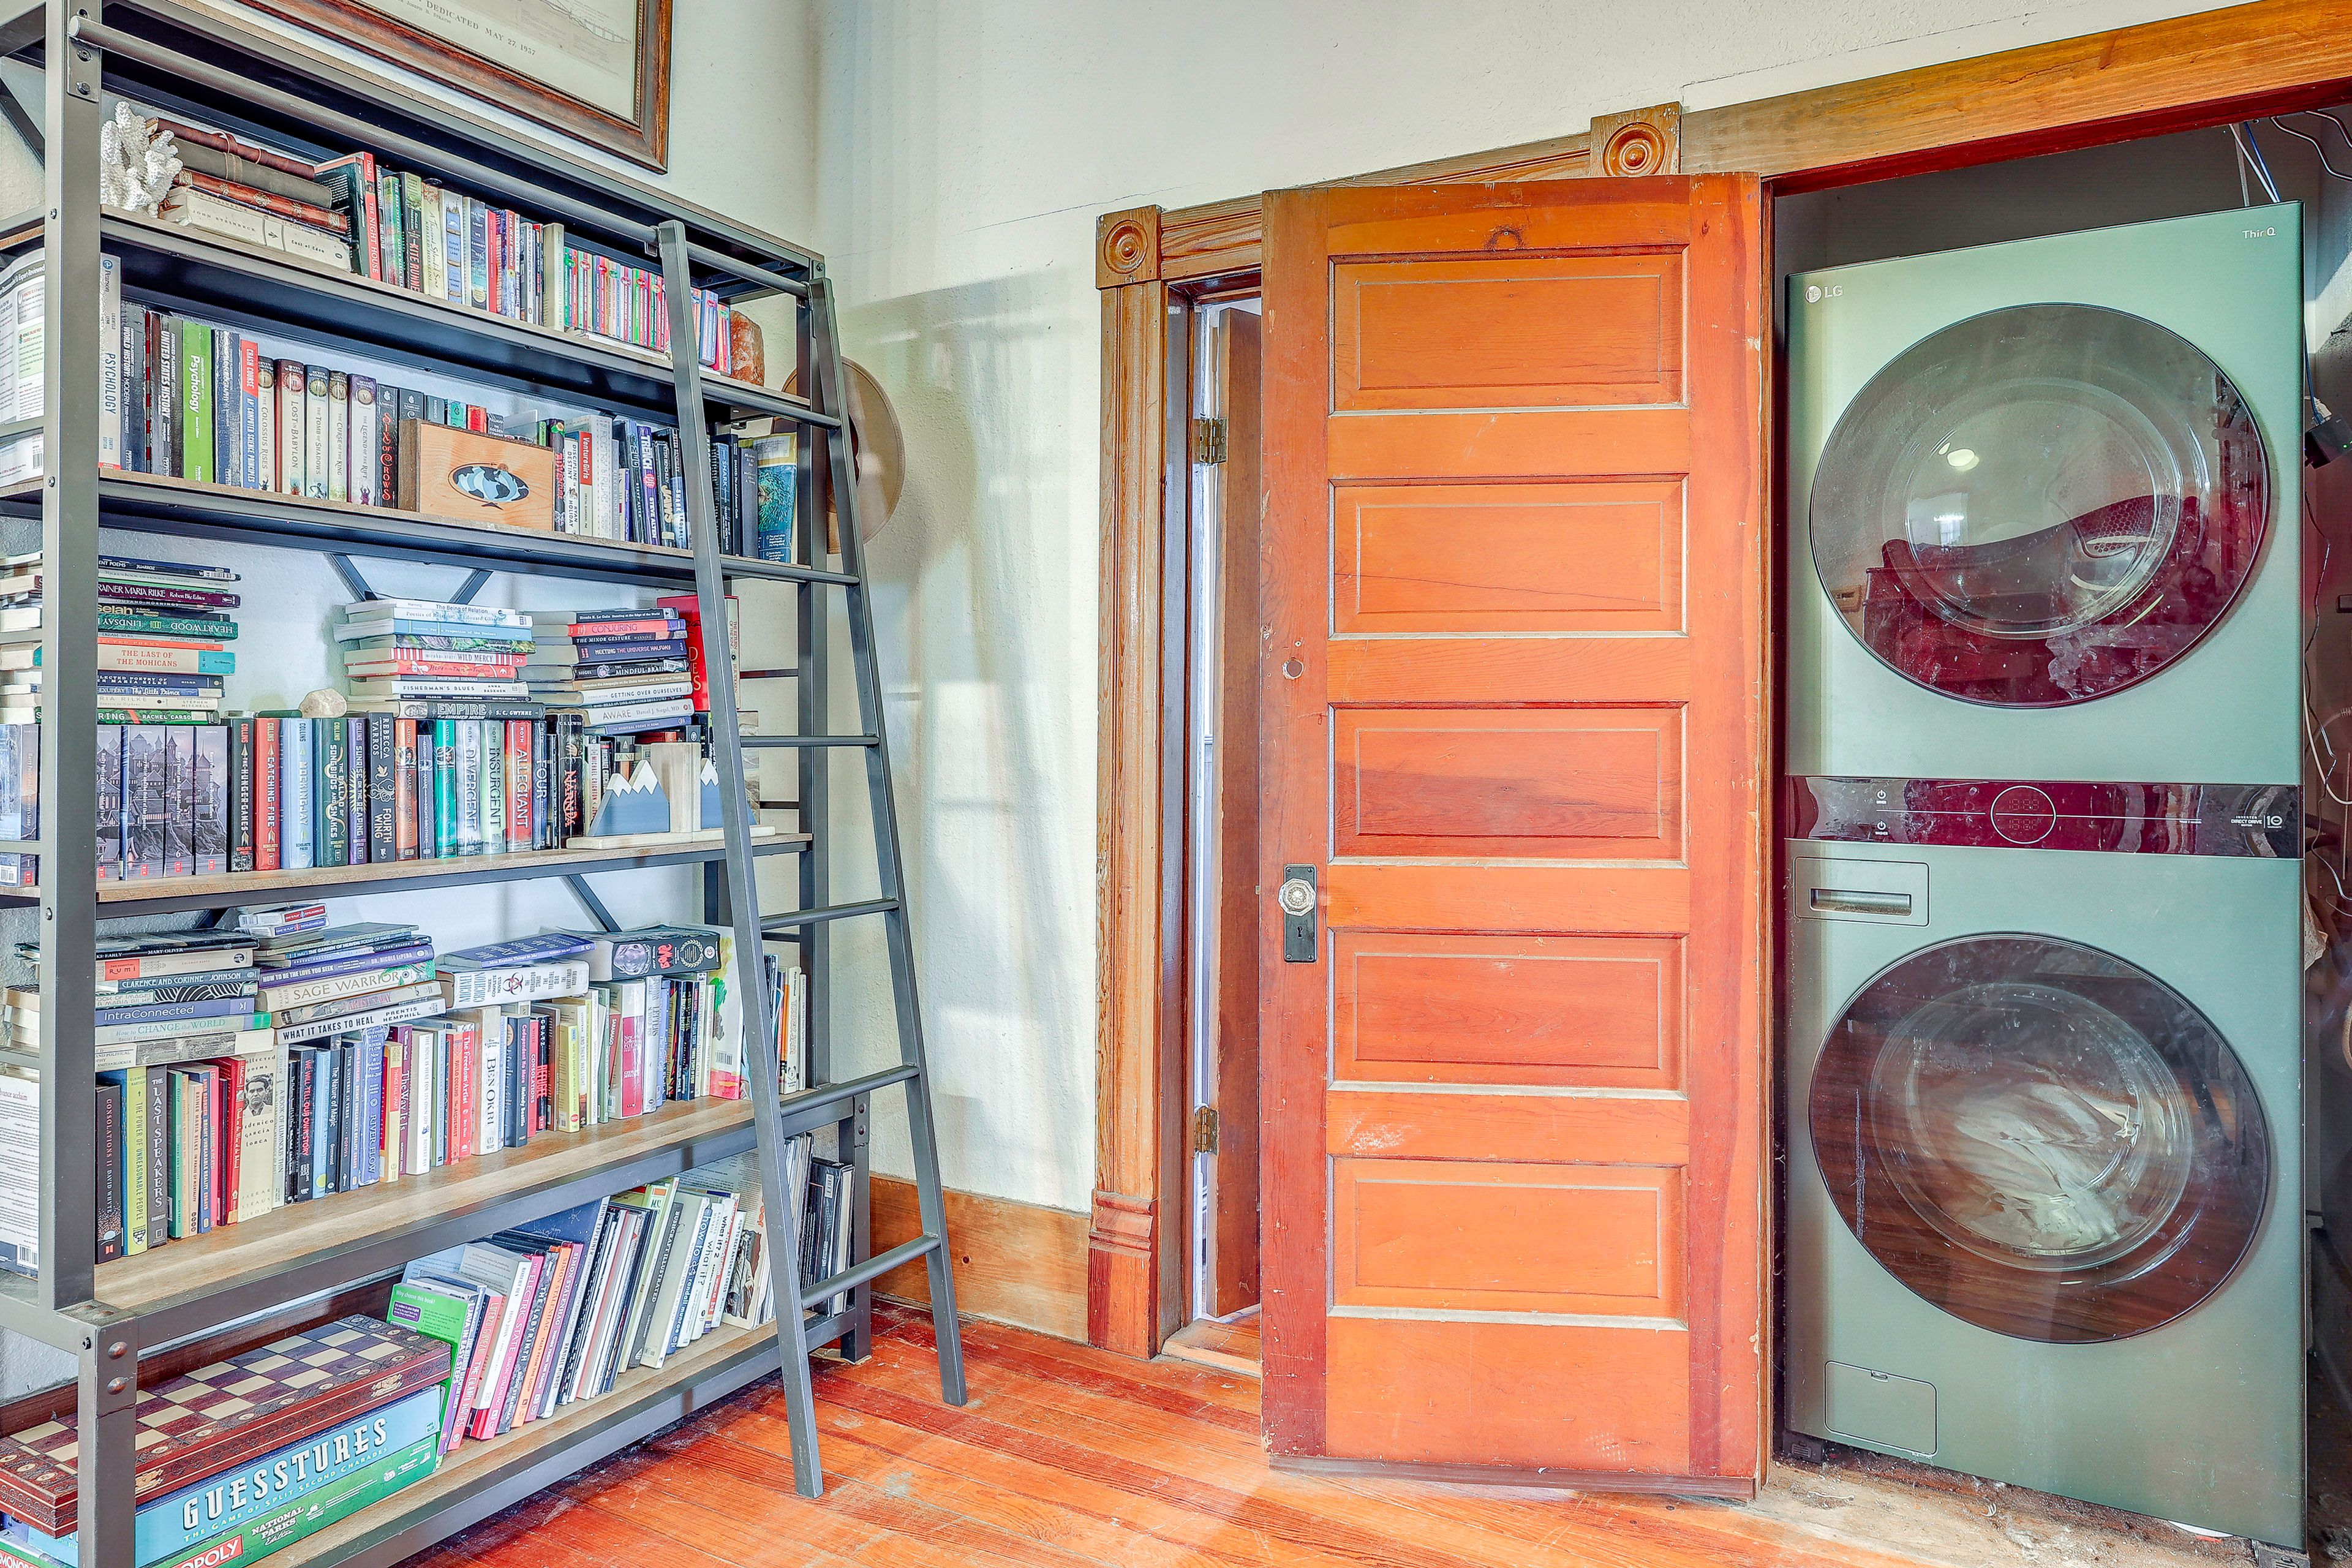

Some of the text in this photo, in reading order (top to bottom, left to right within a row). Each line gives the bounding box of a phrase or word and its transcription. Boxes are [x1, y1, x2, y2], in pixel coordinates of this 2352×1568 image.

[426, 1, 480, 30] DEDICATED
[484, 28, 505, 43] MAY
[192, 209, 256, 232] JOHN STEINBECK
[429, 221, 439, 243] Thousand
[431, 244, 440, 271] Splendid
[1824, 284, 1844, 299] LG
[105, 353, 116, 414] PSYCHOLOGY
[160, 330, 170, 419] UNITED STATES HISTORY
[189, 355, 200, 413] Psychology
[246, 367, 255, 389] COURSE
[382, 413, 391, 443] SIX
[630, 445, 639, 468] MEG
[641, 435, 652, 470] TRENCH
[380, 453, 393, 500] CROWS
[662, 484, 673, 523] JAWS
[171, 622, 234, 633] HEARTWOOD
[592, 624, 638, 633] CONJURING
[474, 654, 493, 663] MERCY
[437, 704, 487, 715] EMPIRE
[603, 710, 631, 720] AWARE
[300, 761, 309, 826] MOCKINGJAY
[467, 748, 477, 830] DIVERGENT
[489, 747, 500, 827] INSURGENT
[516, 748, 528, 827] ALLEGIANT
[536, 761, 548, 799] FOUR
[564, 769, 578, 826] NARNIA
[382, 808, 392, 843] FOURTH
[2266, 816, 2283, 826] 10
[99, 853, 104, 862] 4
[657, 943, 673, 969] BONE
[122, 979, 157, 988] CLARENCE
[173, 975, 203, 985] CORINNE
[209, 972, 241, 981] JOHNSON
[293, 971, 399, 1001] SAGE WARRIOR
[459, 974, 472, 1003] MICHAEL
[473, 972, 486, 1003] CRICHTON
[103, 1005, 194, 1022] IntraConnected
[383, 1011, 421, 1022] HEMPHILL
[386, 1007, 417, 1016] PRENTIS
[282, 1016, 374, 1040] WHAT IT TAKES TO HEAL
[153, 1087, 162, 1125] LAST
[486, 1058, 496, 1126] BEN OKRI
[153, 1128, 163, 1207] SPEAKERS
[396, 1290, 435, 1305] Why choose this book?
[521, 1286, 547, 1362] THE LABYRINTH
[183, 1417, 388, 1531] GUESSTURES
[183, 1529, 205, 1543] THE
[211, 1513, 243, 1529] GAME
[247, 1504, 260, 1515] OF
[265, 1471, 336, 1506] SPLIT-SECOND
[341, 1447, 388, 1472] CHARADES
[251, 1505, 304, 1536] NATIONAL
[261, 1518, 297, 1540] PARKS
[264, 1529, 294, 1545] Edition
